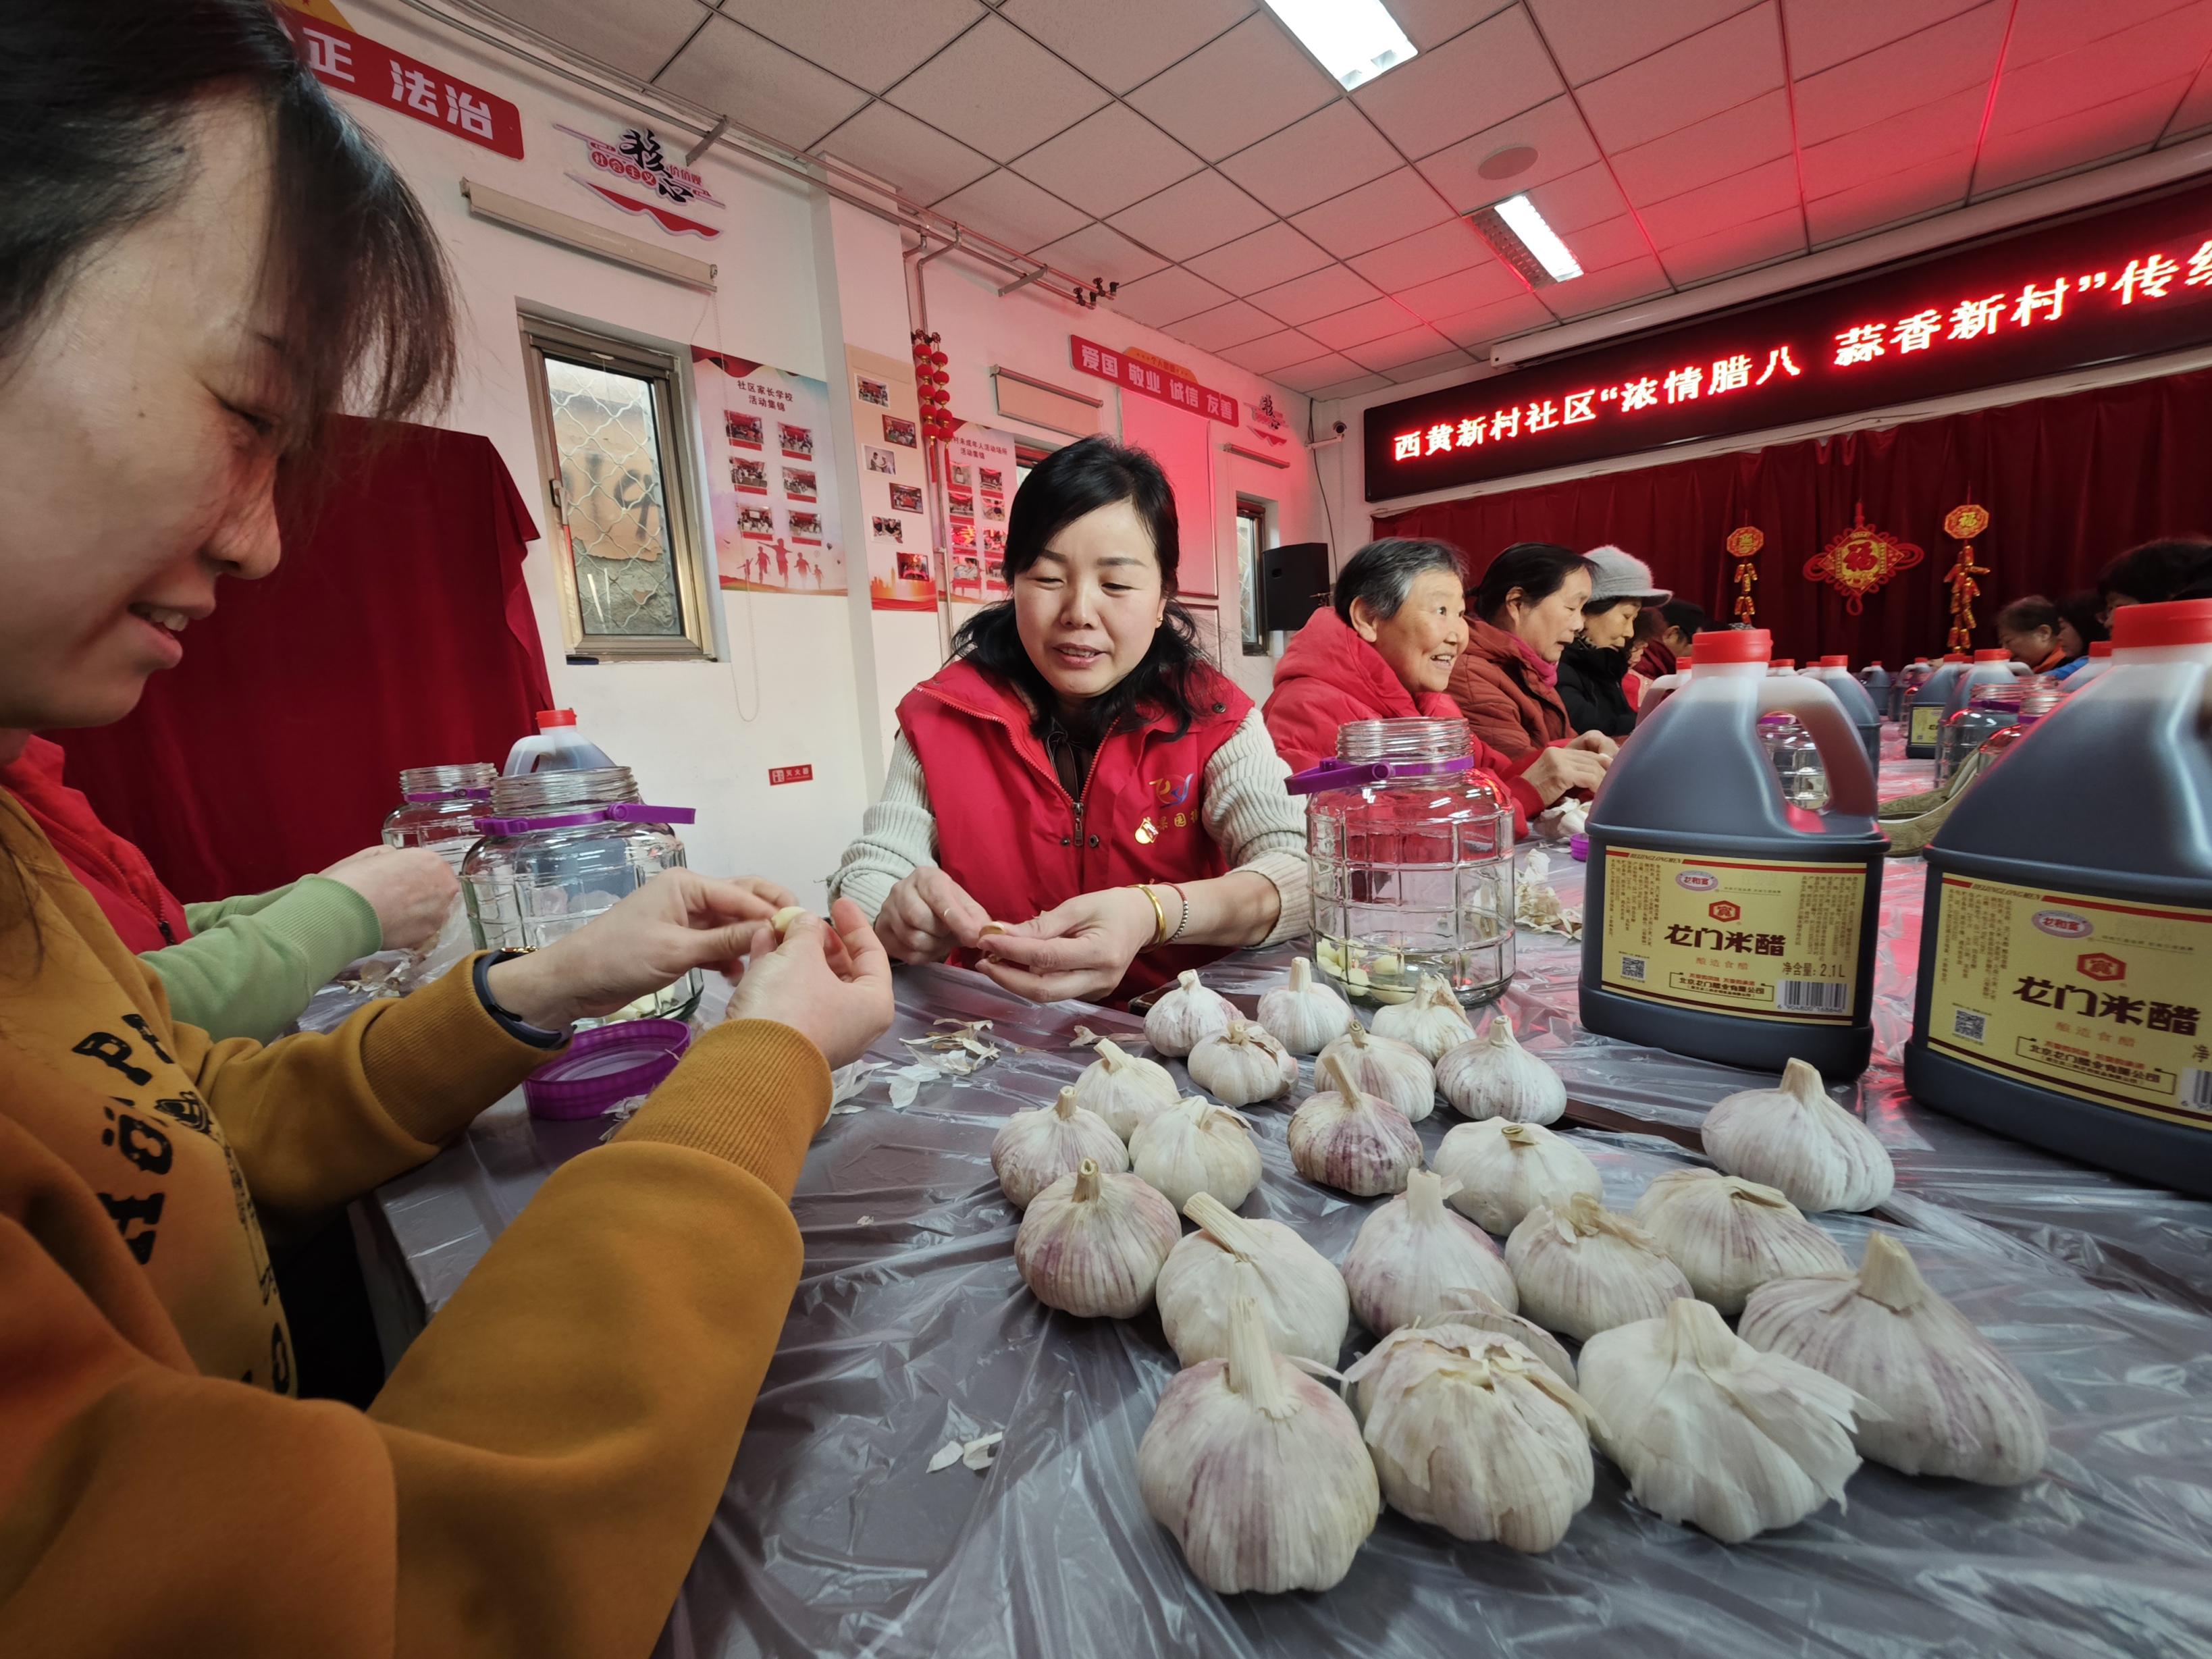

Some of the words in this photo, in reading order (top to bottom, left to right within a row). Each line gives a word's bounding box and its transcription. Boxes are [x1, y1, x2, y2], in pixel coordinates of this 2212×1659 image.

[390, 59, 493, 140] 法治
[591, 151, 657, 186] 社会主义
[737, 380, 793, 402] 社区家长学校
[1082, 344, 1118, 379] 爱国
[1128, 363, 1161, 394] 敬业
[1169, 378, 1199, 408] 诚信
[1207, 394, 1233, 420] 友善
[748, 395, 786, 412] 活动集锦
[1394, 346, 1801, 462] 西黄新村社区“浓情腊八
[1843, 542, 1878, 572] 福
[1664, 924, 1787, 957] 龙门米醋
[2013, 976, 2202, 1036] 龙门米醋
